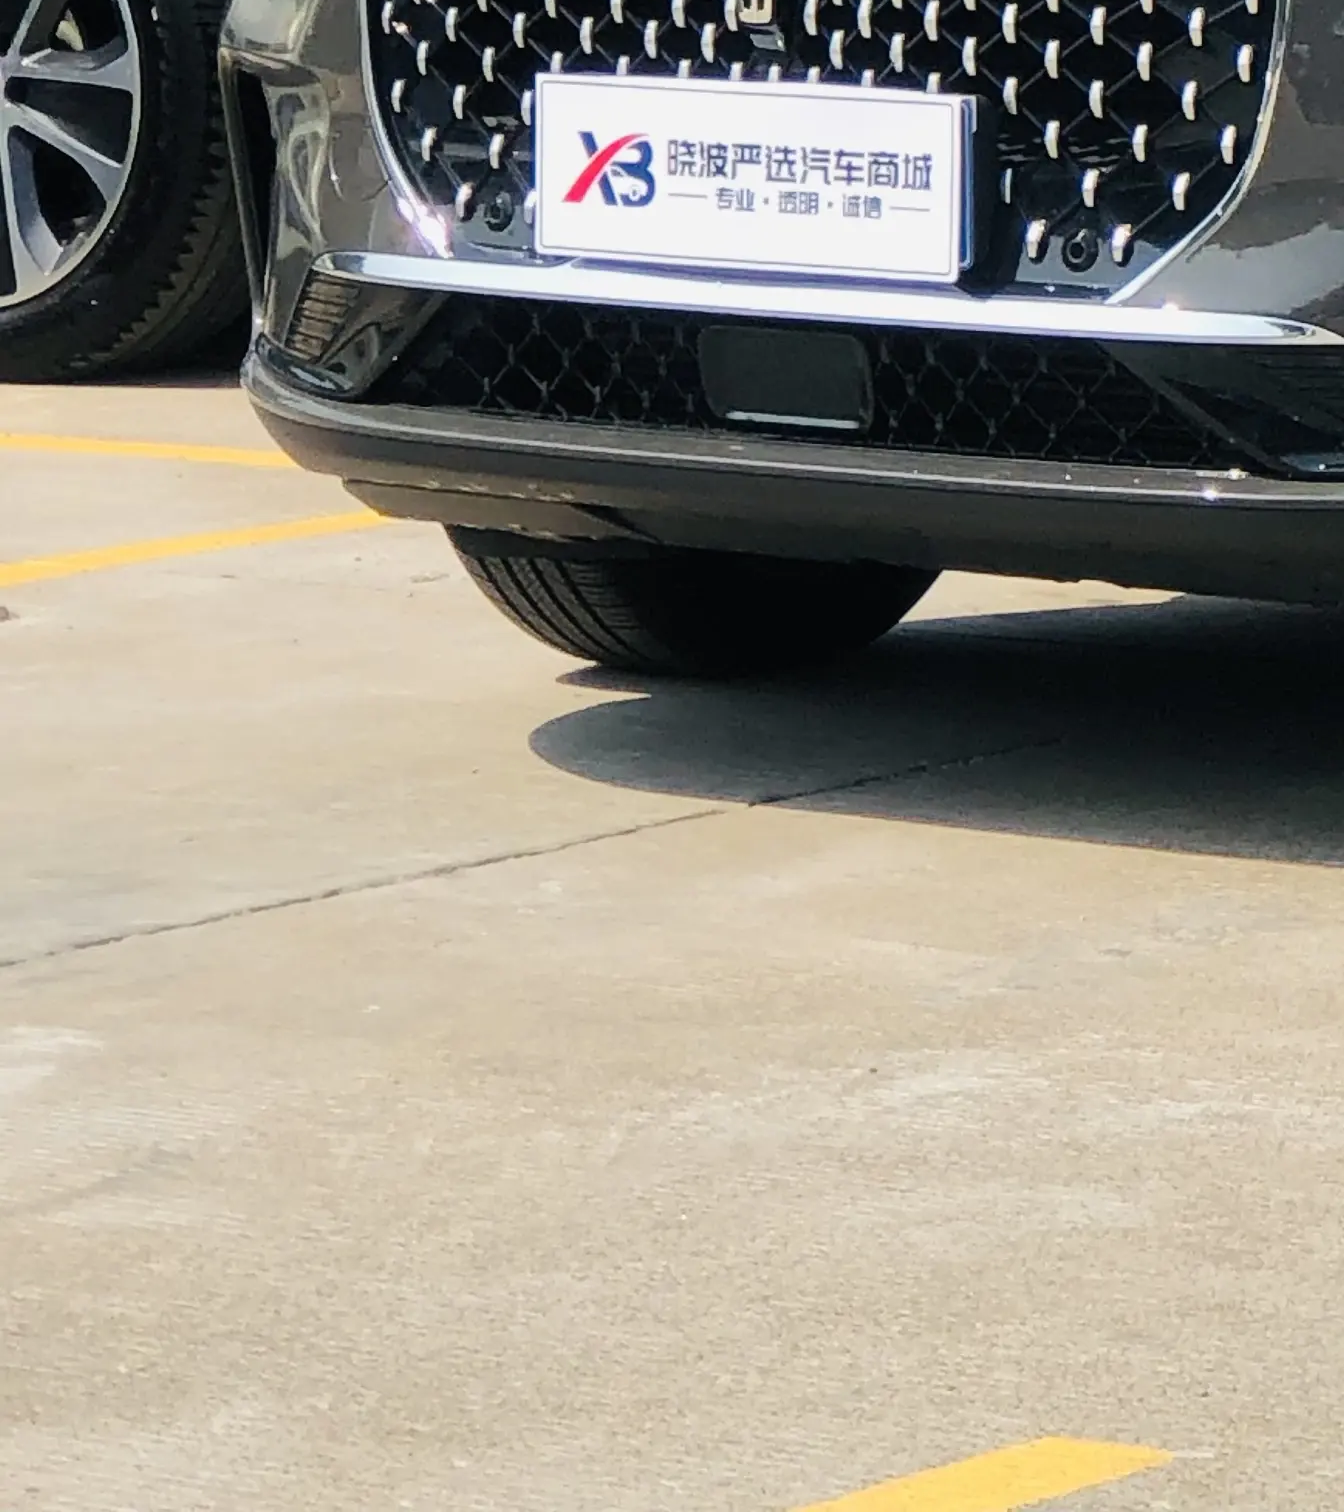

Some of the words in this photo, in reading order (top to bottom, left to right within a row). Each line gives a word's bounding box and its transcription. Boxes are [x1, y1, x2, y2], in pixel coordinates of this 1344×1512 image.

[667, 138, 932, 191] 晓波严选汽车商城
